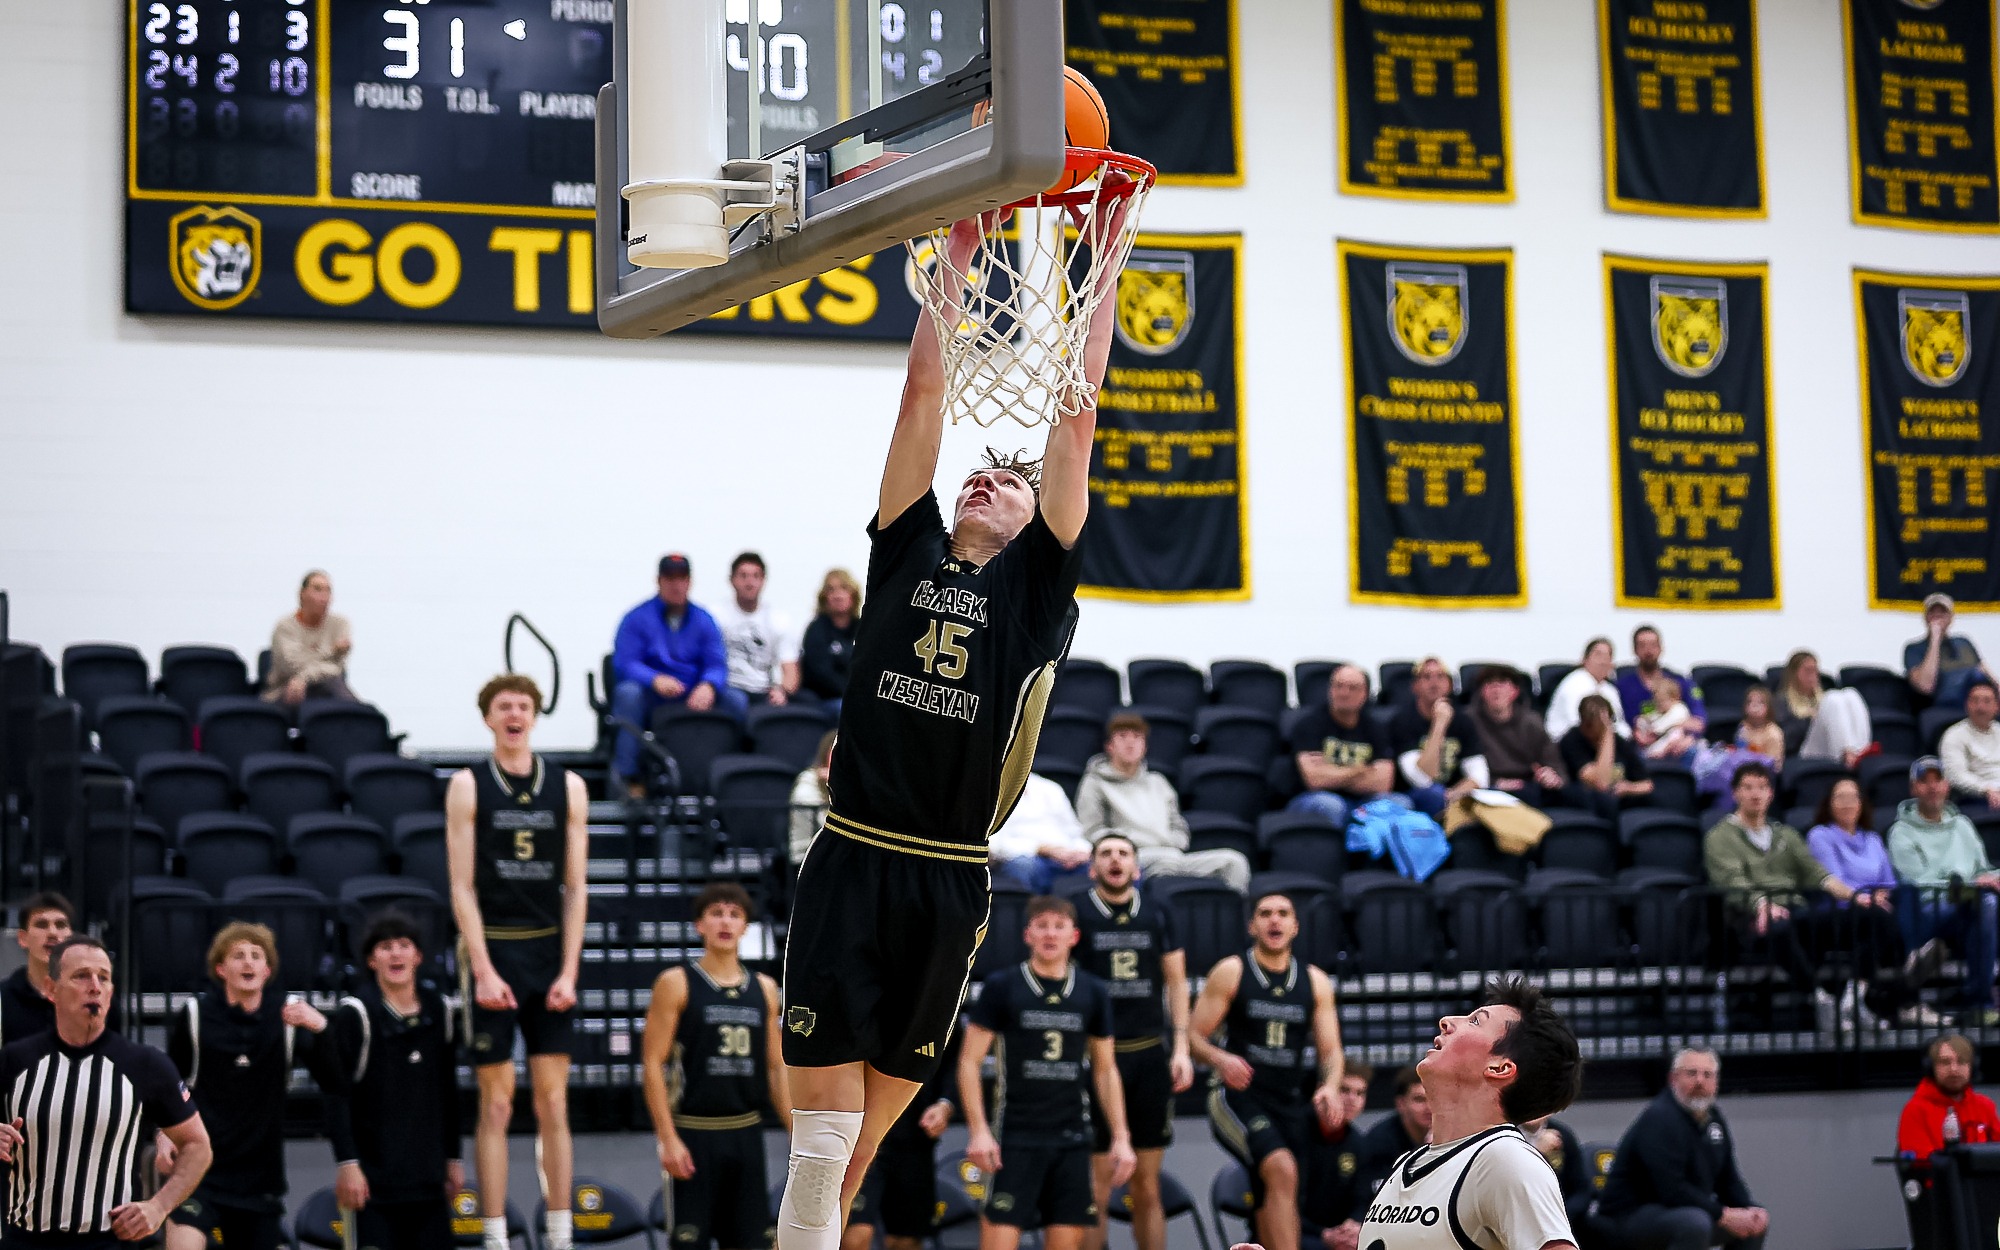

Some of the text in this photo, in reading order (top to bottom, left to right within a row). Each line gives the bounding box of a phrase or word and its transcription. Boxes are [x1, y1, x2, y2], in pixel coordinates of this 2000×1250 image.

[145, 3, 308, 51] 23 1 3
[145, 50, 308, 96] 24 2 10
[353, 82, 424, 111] FOULS
[351, 172, 422, 201] SCORE
[294, 219, 461, 309] GO
[914, 618, 975, 680] 45
[876, 670, 980, 724] WESLEYAN
[513, 831, 535, 860] 5
[718, 1025, 751, 1057] 30
[1042, 1030, 1063, 1061] 3
[1365, 1203, 1440, 1227] OLORADO
